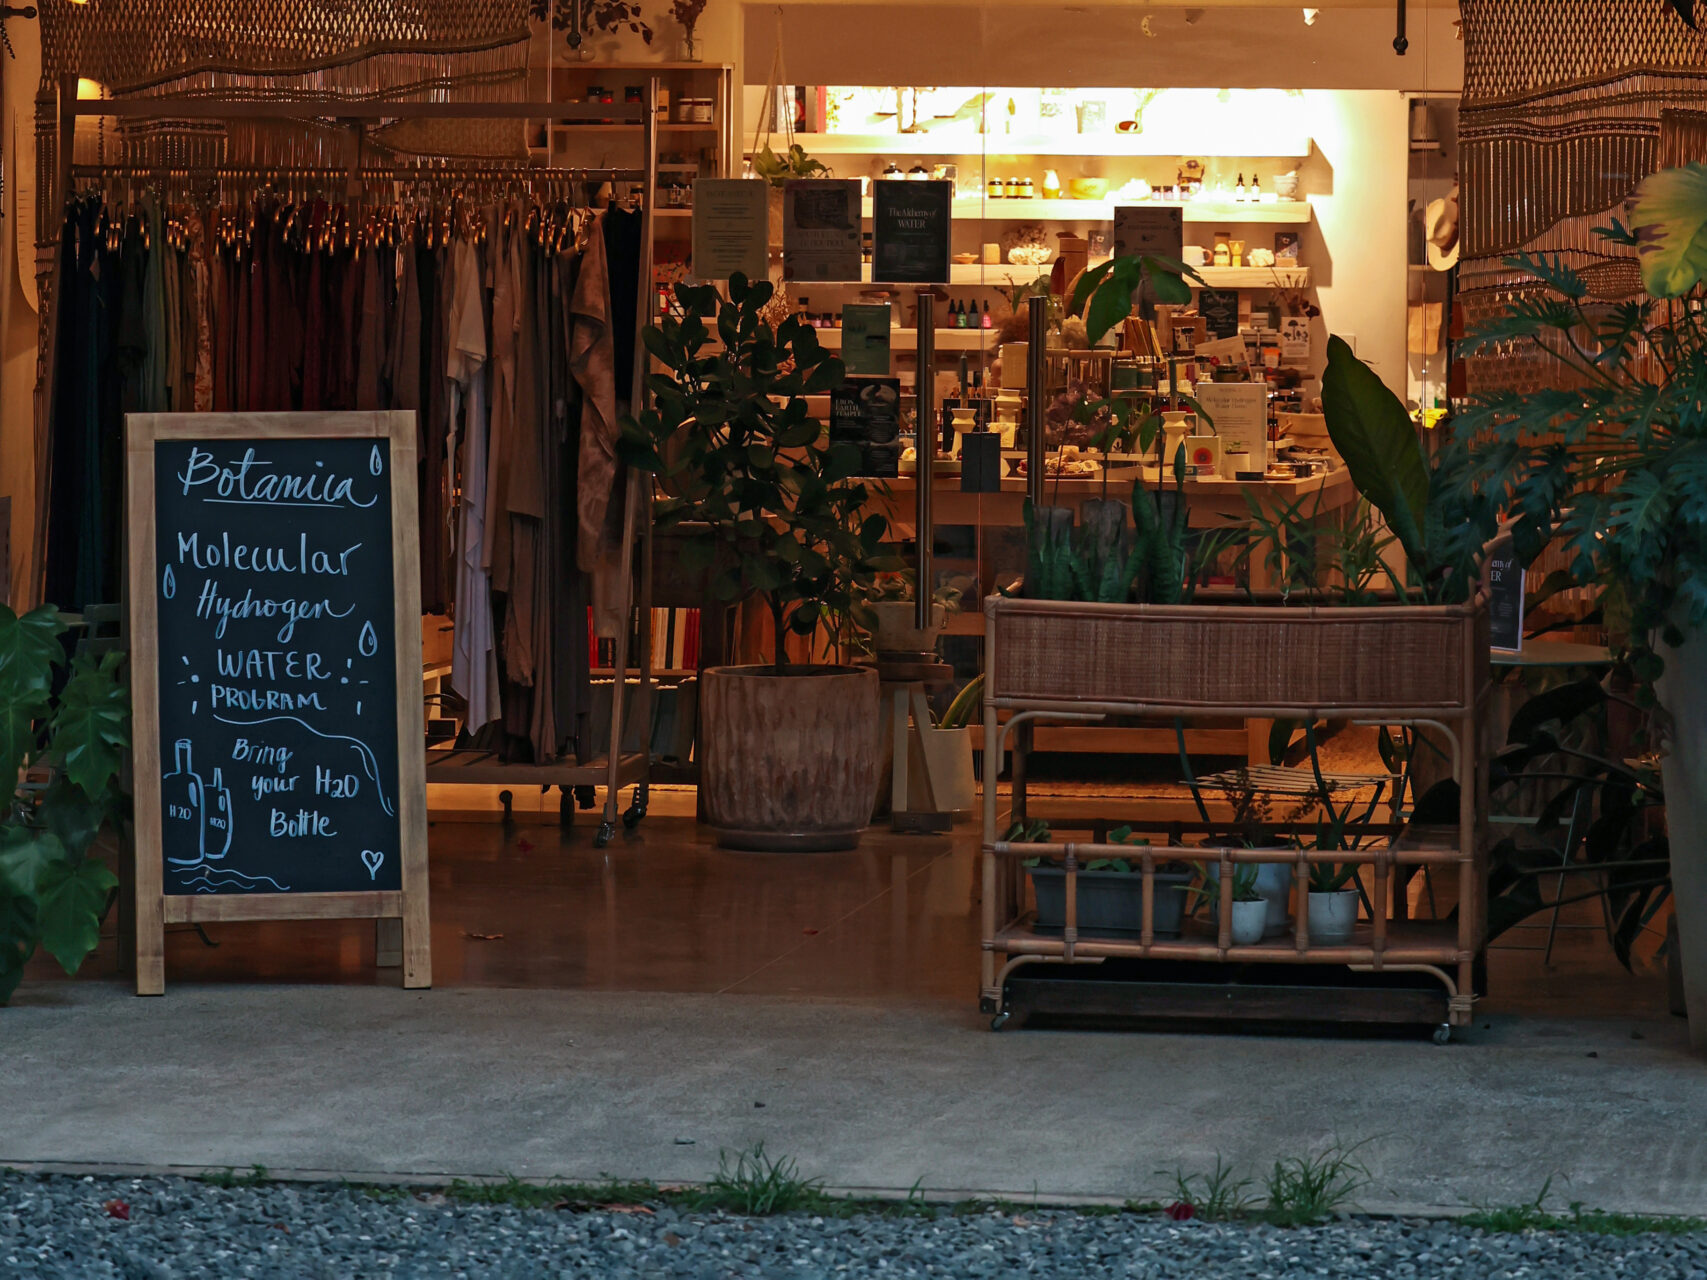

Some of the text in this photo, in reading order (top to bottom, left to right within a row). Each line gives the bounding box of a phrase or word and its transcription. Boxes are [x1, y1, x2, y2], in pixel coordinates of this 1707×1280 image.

[888, 207, 901, 217] The
[902, 207, 929, 220] Alchemy
[897, 219, 927, 229] WATER
[178, 446, 377, 507] Botanica
[178, 531, 362, 576] Molecular
[197, 578, 355, 643] Hydrogen
[217, 648, 331, 681] WATER
[211, 683, 327, 711] PROGRAM
[232, 738, 293, 774] Bring
[251, 764, 360, 801] your H2O
[169, 804, 192, 820] H2O
[269, 807, 338, 838] Bottle
